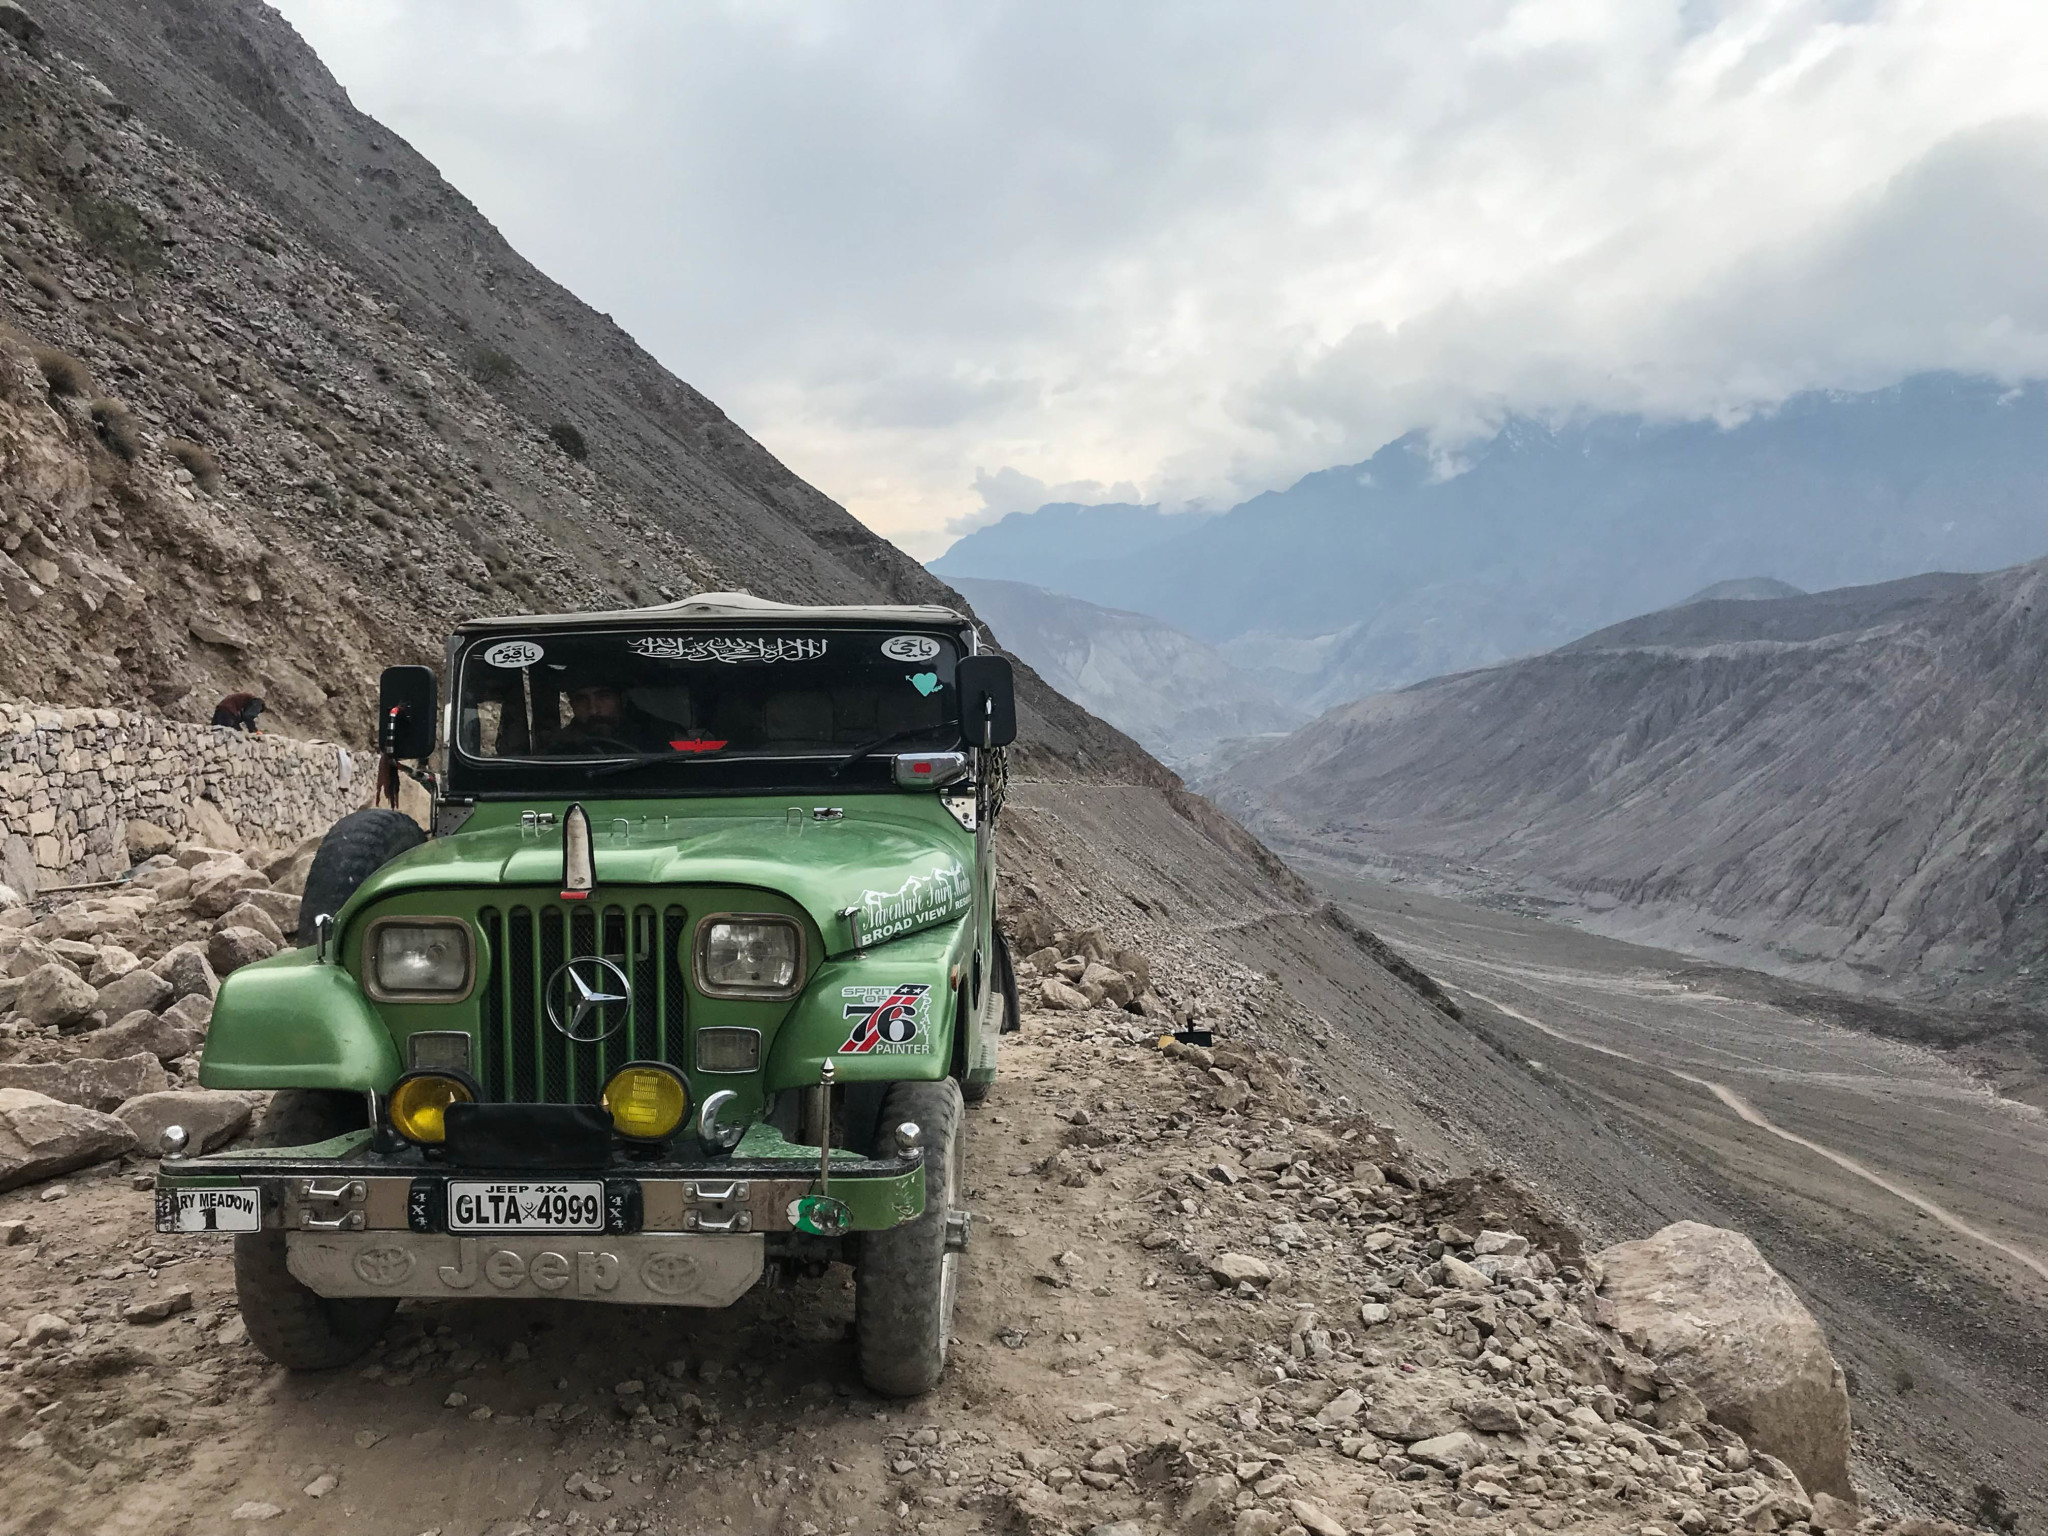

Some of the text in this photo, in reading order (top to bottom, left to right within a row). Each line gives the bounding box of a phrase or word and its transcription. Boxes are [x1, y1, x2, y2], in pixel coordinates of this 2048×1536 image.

[861, 917, 913, 946] BROAD
[915, 905, 947, 924] VIEW
[843, 988, 895, 996] SPIRIT
[864, 995, 887, 1003] OF
[843, 1003, 918, 1043] 76
[875, 1044, 930, 1054] PAINTER
[485, 1185, 569, 1194] JEEP 4X4
[199, 1193, 255, 1215] MEADOW
[455, 1194, 598, 1225] GLTA 4999
[198, 1206, 219, 1230] 1
[438, 1238, 619, 1295] Jeep
